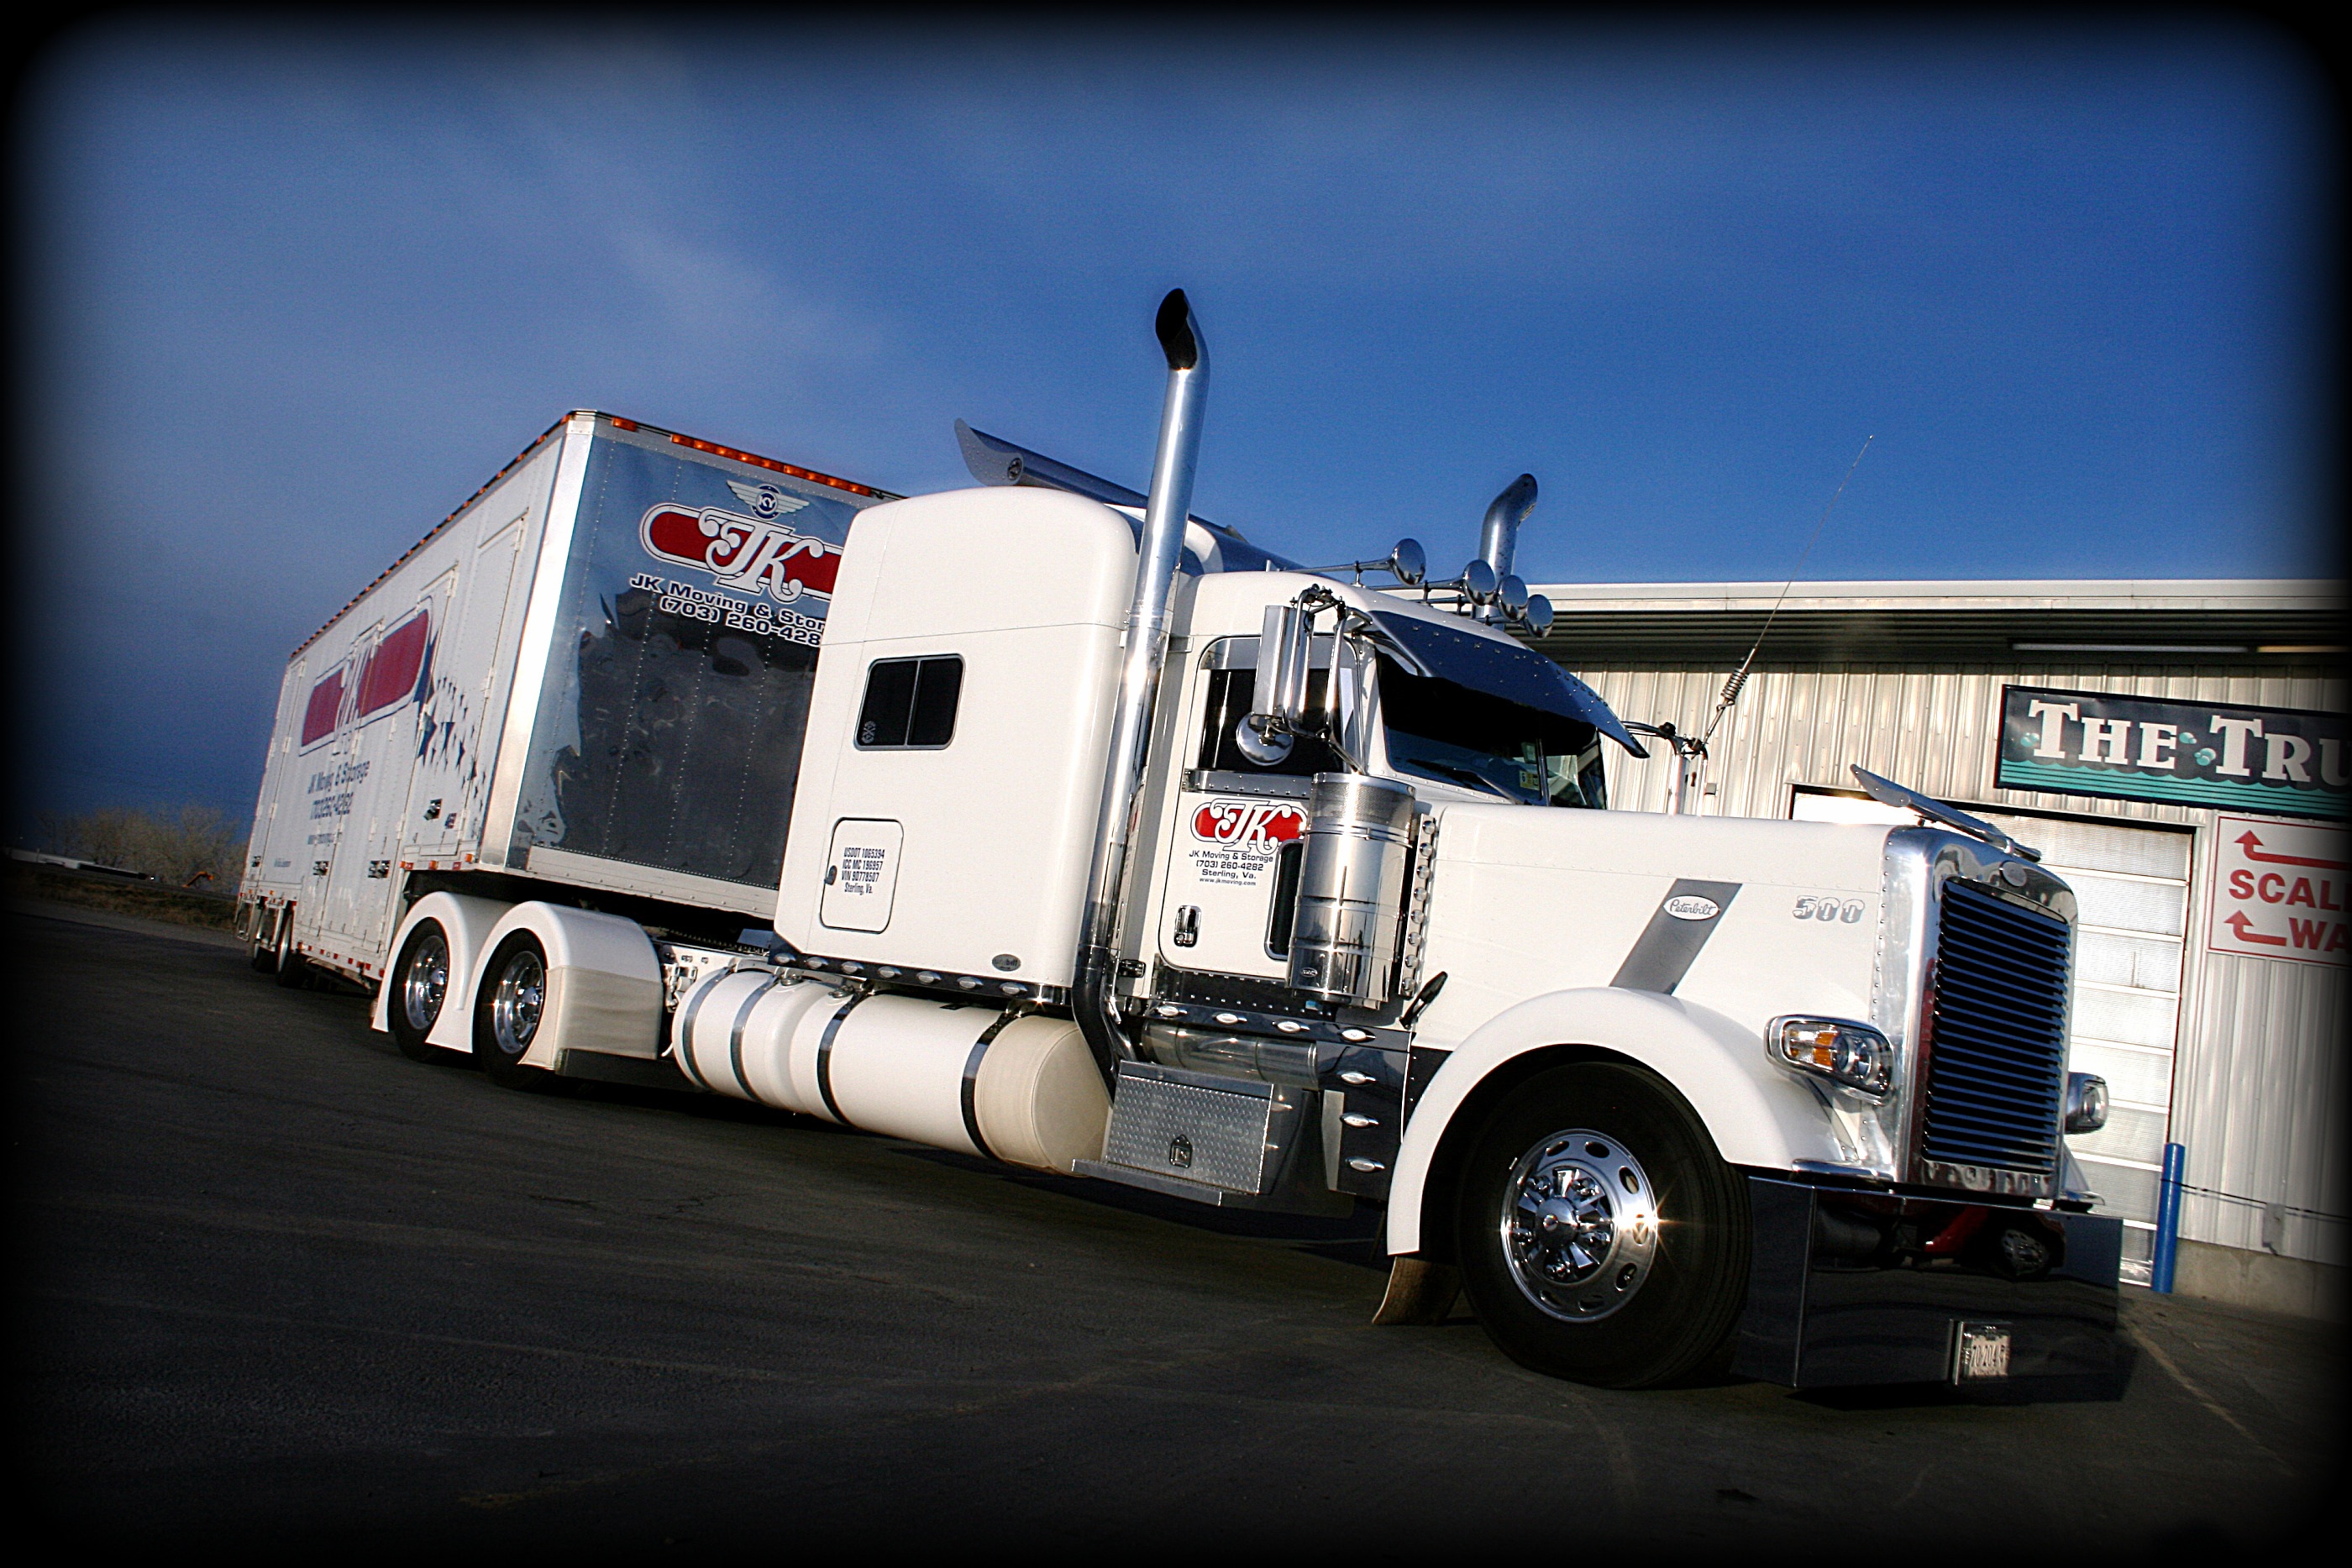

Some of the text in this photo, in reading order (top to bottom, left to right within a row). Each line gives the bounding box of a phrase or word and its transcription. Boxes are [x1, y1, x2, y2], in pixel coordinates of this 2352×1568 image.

[699, 507, 825, 604] JK
[630, 573, 664, 593] JK
[668, 580, 748, 611] Moving
[754, 603, 772, 619] &
[660, 595, 822, 646] (703) 260-428
[2028, 699, 2178, 770] THE
[1210, 798, 1292, 855] JK
[843, 847, 861, 858] USDOT
[1189, 850, 1200, 858] JK
[1202, 850, 1230, 861] Moving
[1241, 852, 1273, 863] Storage
[852, 859, 862, 869] MC
[1196, 860, 1264, 871] (703) 260-4282
[1201, 868, 1257, 879] Sterling, Va.
[1199, 878, 1256, 886] www.jkmoving.com
[1669, 899, 1716, 915] Peterbilt
[1792, 895, 1866, 924] 500
